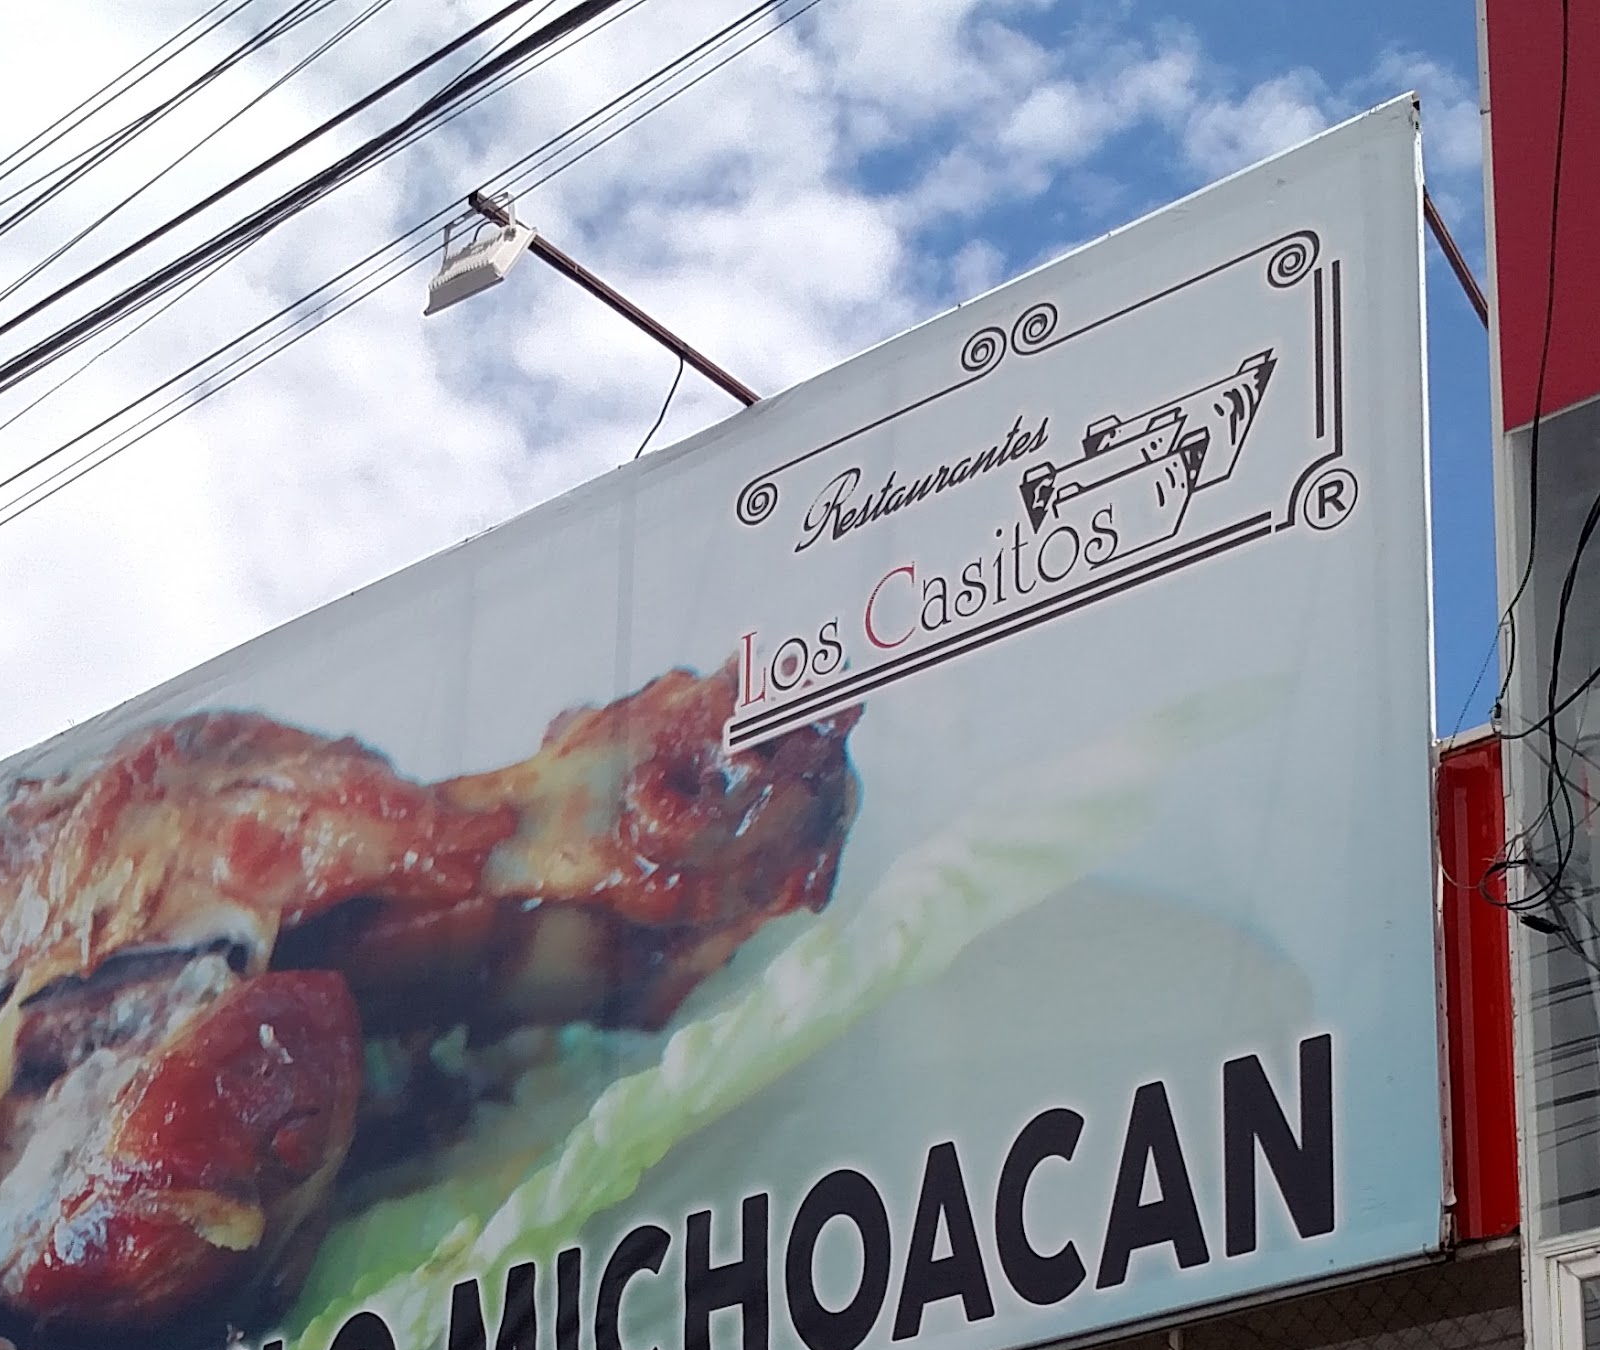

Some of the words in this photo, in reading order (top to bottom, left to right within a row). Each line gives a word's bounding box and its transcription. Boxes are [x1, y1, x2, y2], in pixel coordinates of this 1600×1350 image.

[796, 415, 1049, 552] Restaurantes
[740, 617, 843, 707] Los
[864, 503, 1119, 651] Casitos
